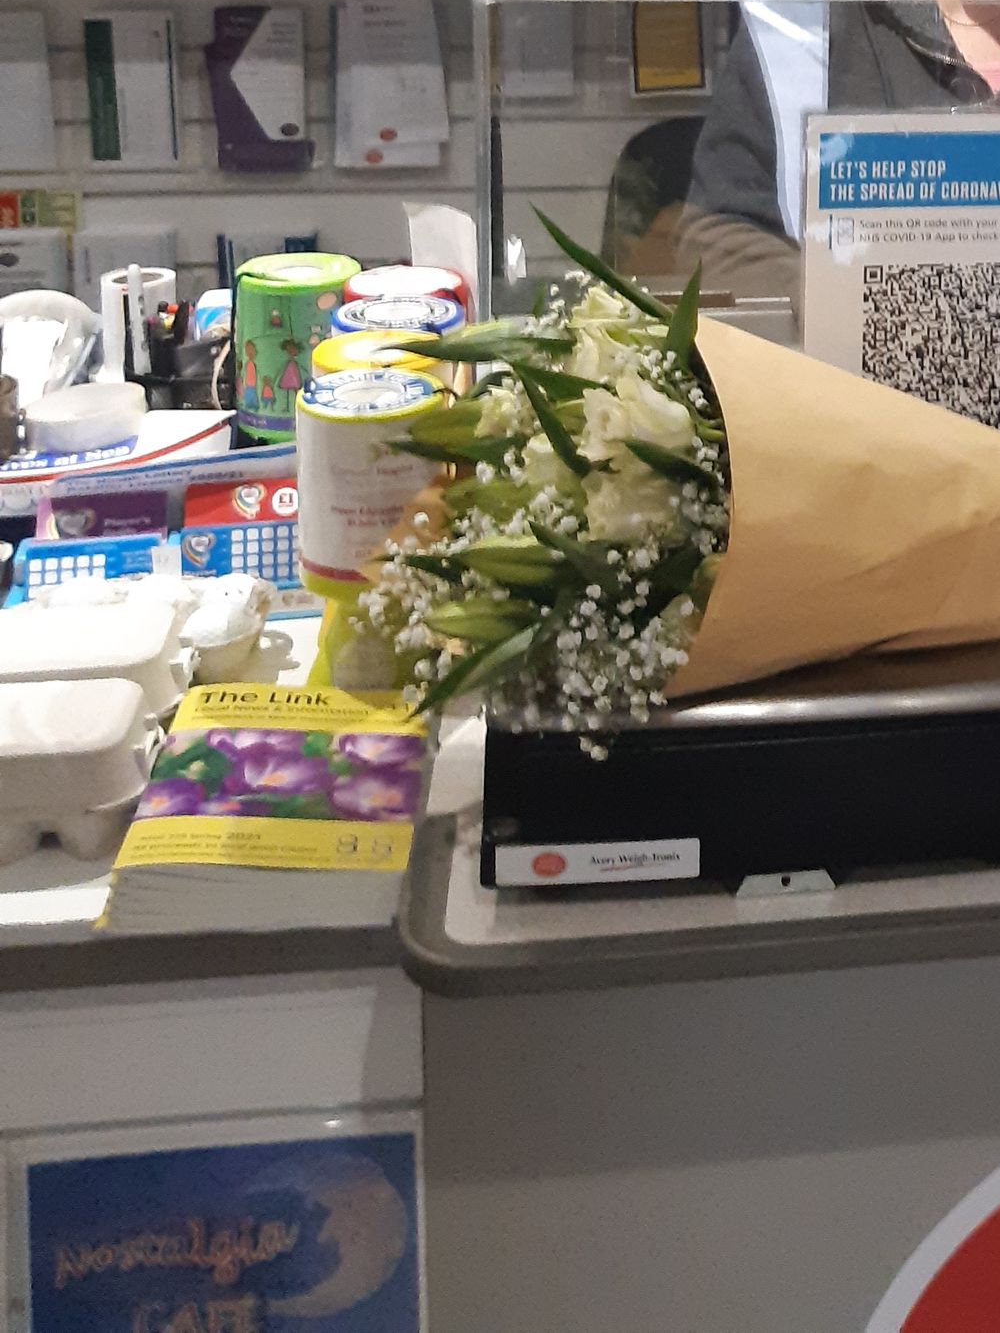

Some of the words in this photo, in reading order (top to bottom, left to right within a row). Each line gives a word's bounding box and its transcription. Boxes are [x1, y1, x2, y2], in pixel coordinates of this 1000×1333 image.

[830, 160, 868, 180] LET'S
[871, 160, 906, 180] HELP
[911, 159, 946, 179] STOP
[829, 182, 855, 202] THE
[860, 181, 915, 202] SPREAD
[919, 181, 936, 200] OF
[885, 218, 903, 229] this
[924, 218, 948, 229] code
[950, 217, 973, 228] with
[976, 218, 998, 230] your
[934, 232, 956, 244] App
[958, 232, 969, 242] to
[201, 691, 259, 705] The
[269, 691, 330, 706] Link
